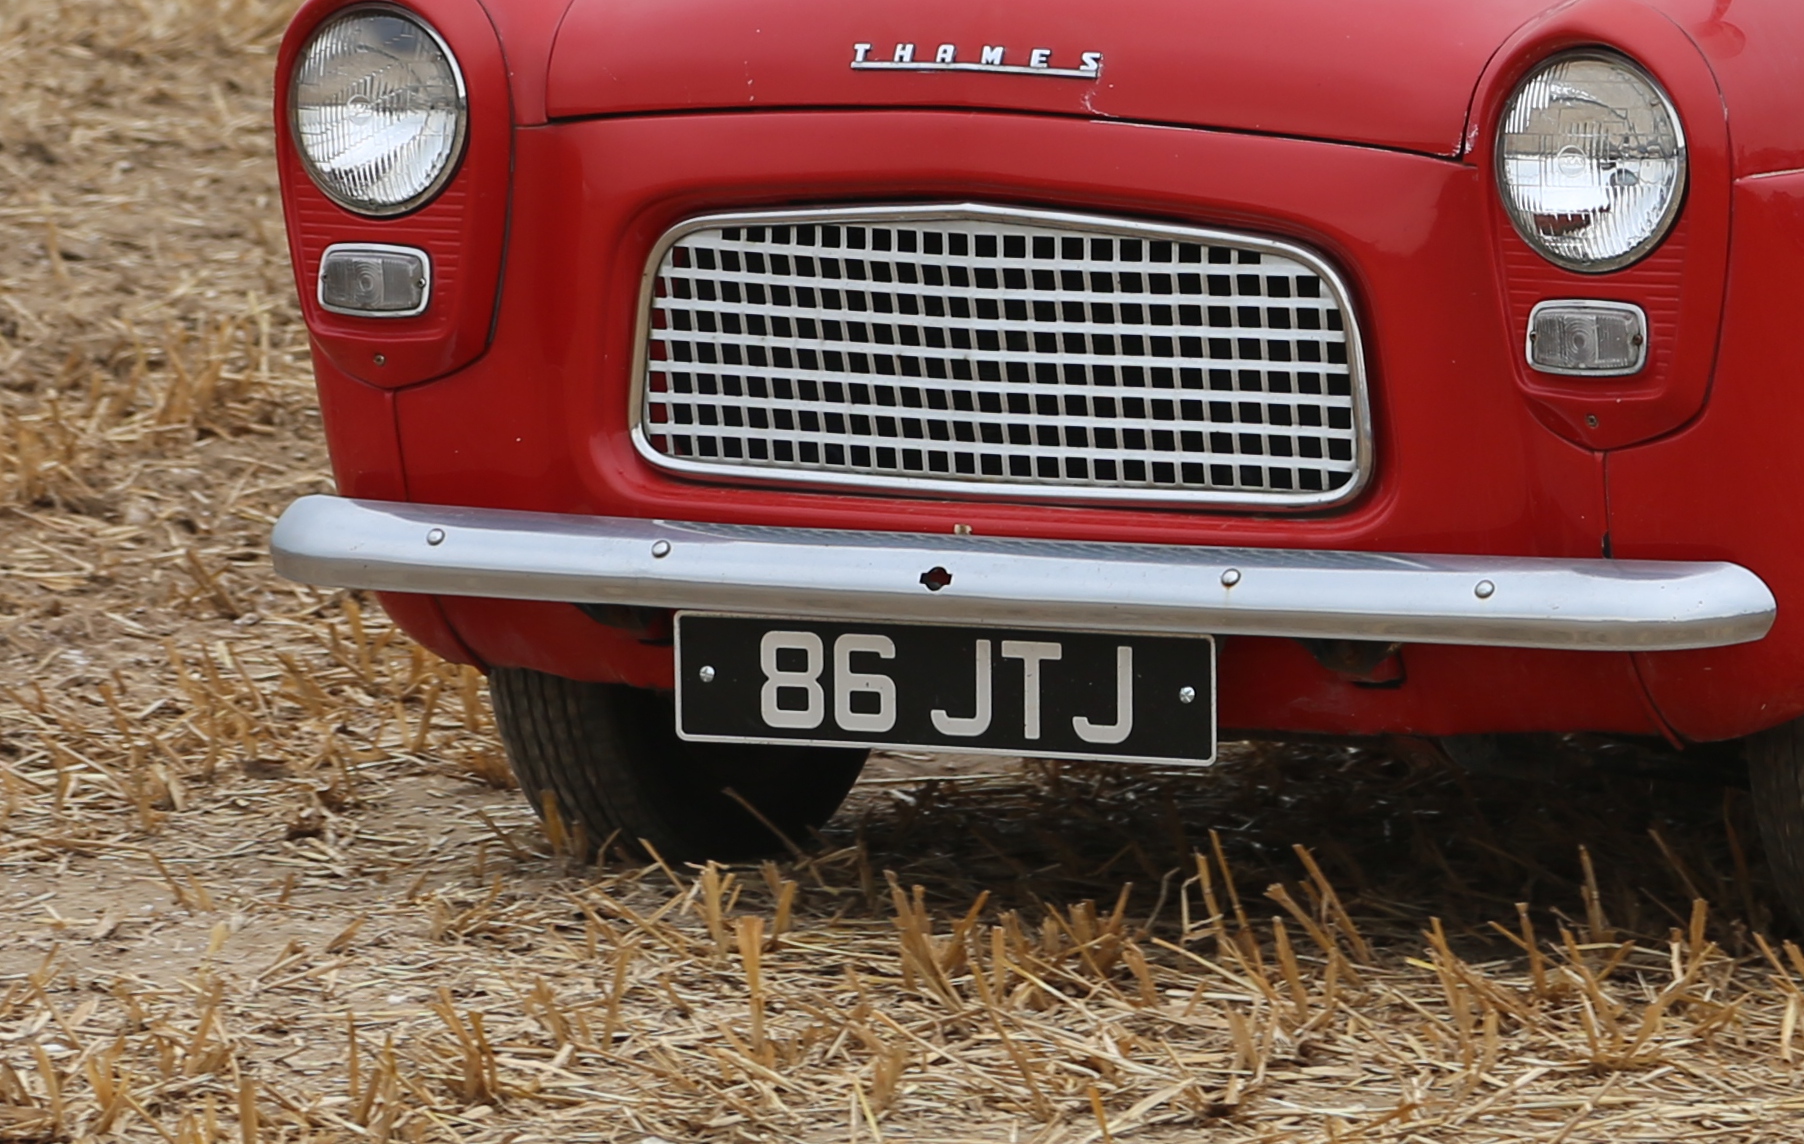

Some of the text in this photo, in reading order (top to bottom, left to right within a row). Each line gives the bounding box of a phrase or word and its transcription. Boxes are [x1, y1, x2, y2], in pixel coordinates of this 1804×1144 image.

[853, 43, 1104, 71] THAMES
[760, 630, 1133, 744] 86 JTJ
